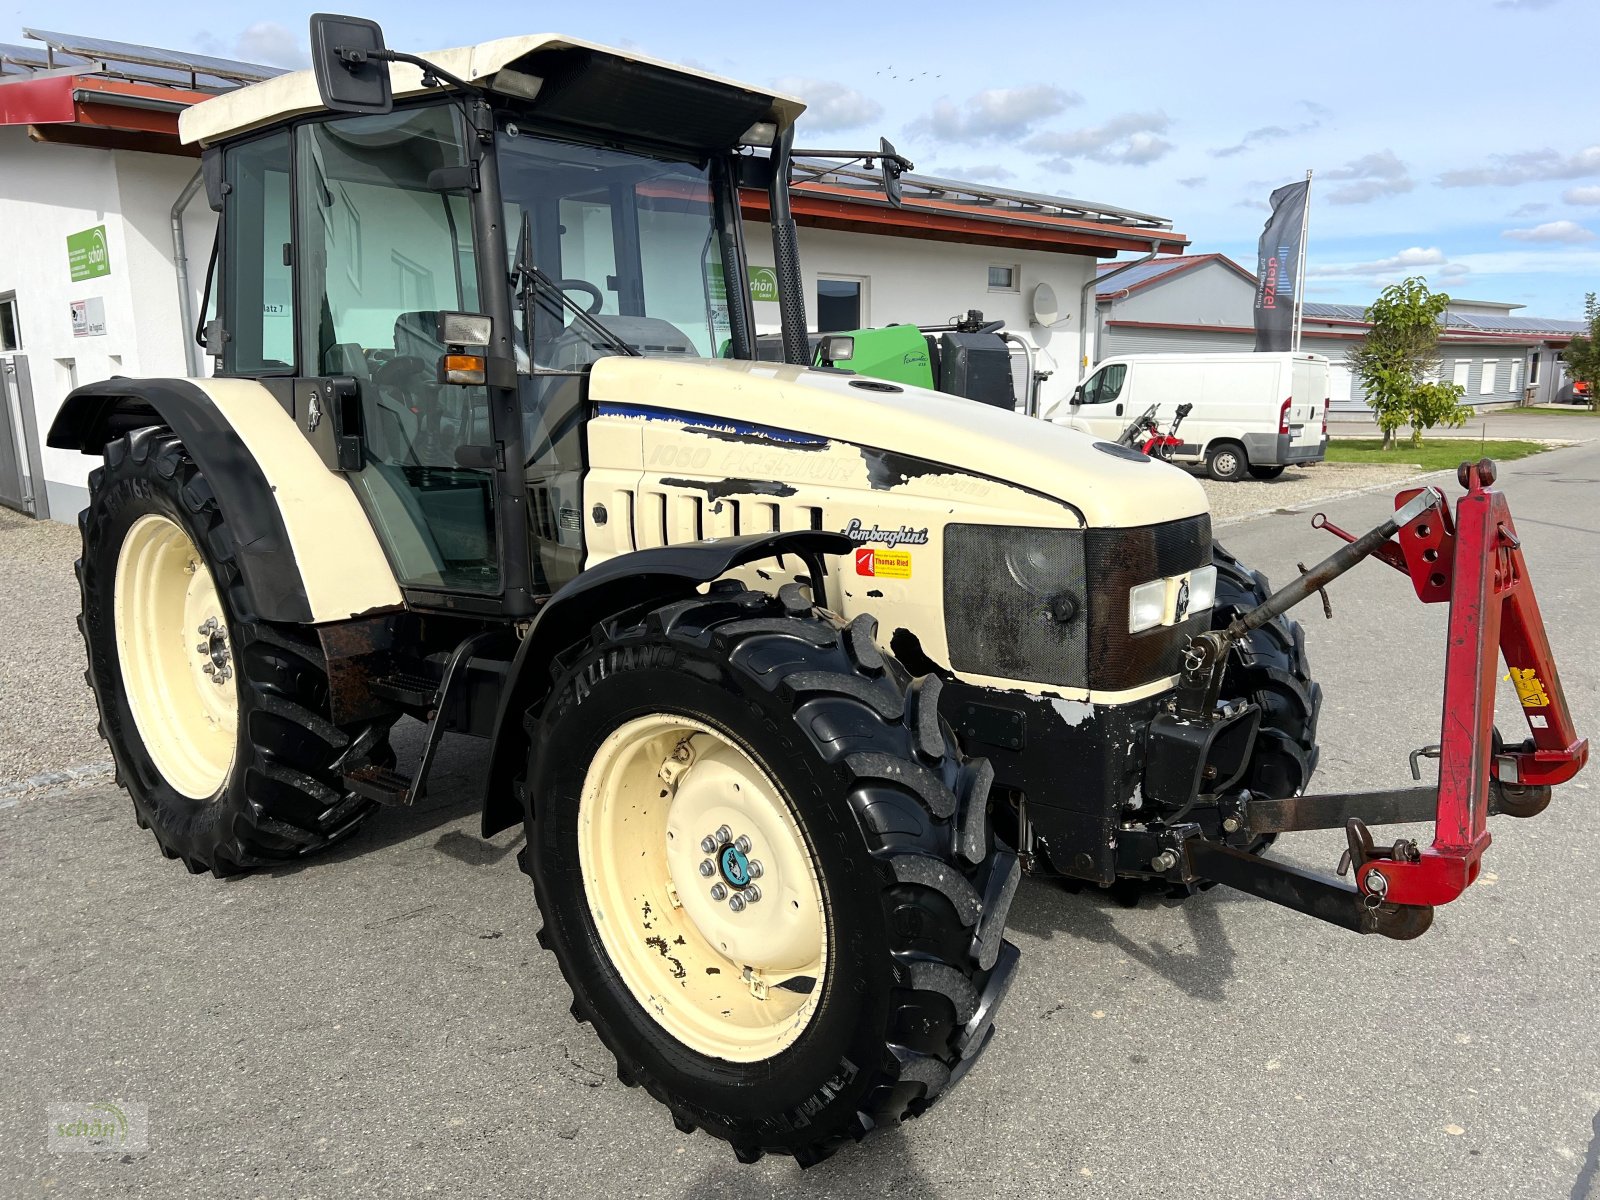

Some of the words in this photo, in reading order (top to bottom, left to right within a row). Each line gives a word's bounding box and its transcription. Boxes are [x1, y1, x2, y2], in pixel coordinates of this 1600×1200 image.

[88, 245, 104, 264] schön
[750, 278, 772, 292] chön
[1263, 257, 1279, 309] denzel
[263, 304, 277, 313] latz
[279, 304, 283, 313] 7
[842, 518, 928, 548] Lamborghini
[875, 558, 895, 566] Thomas
